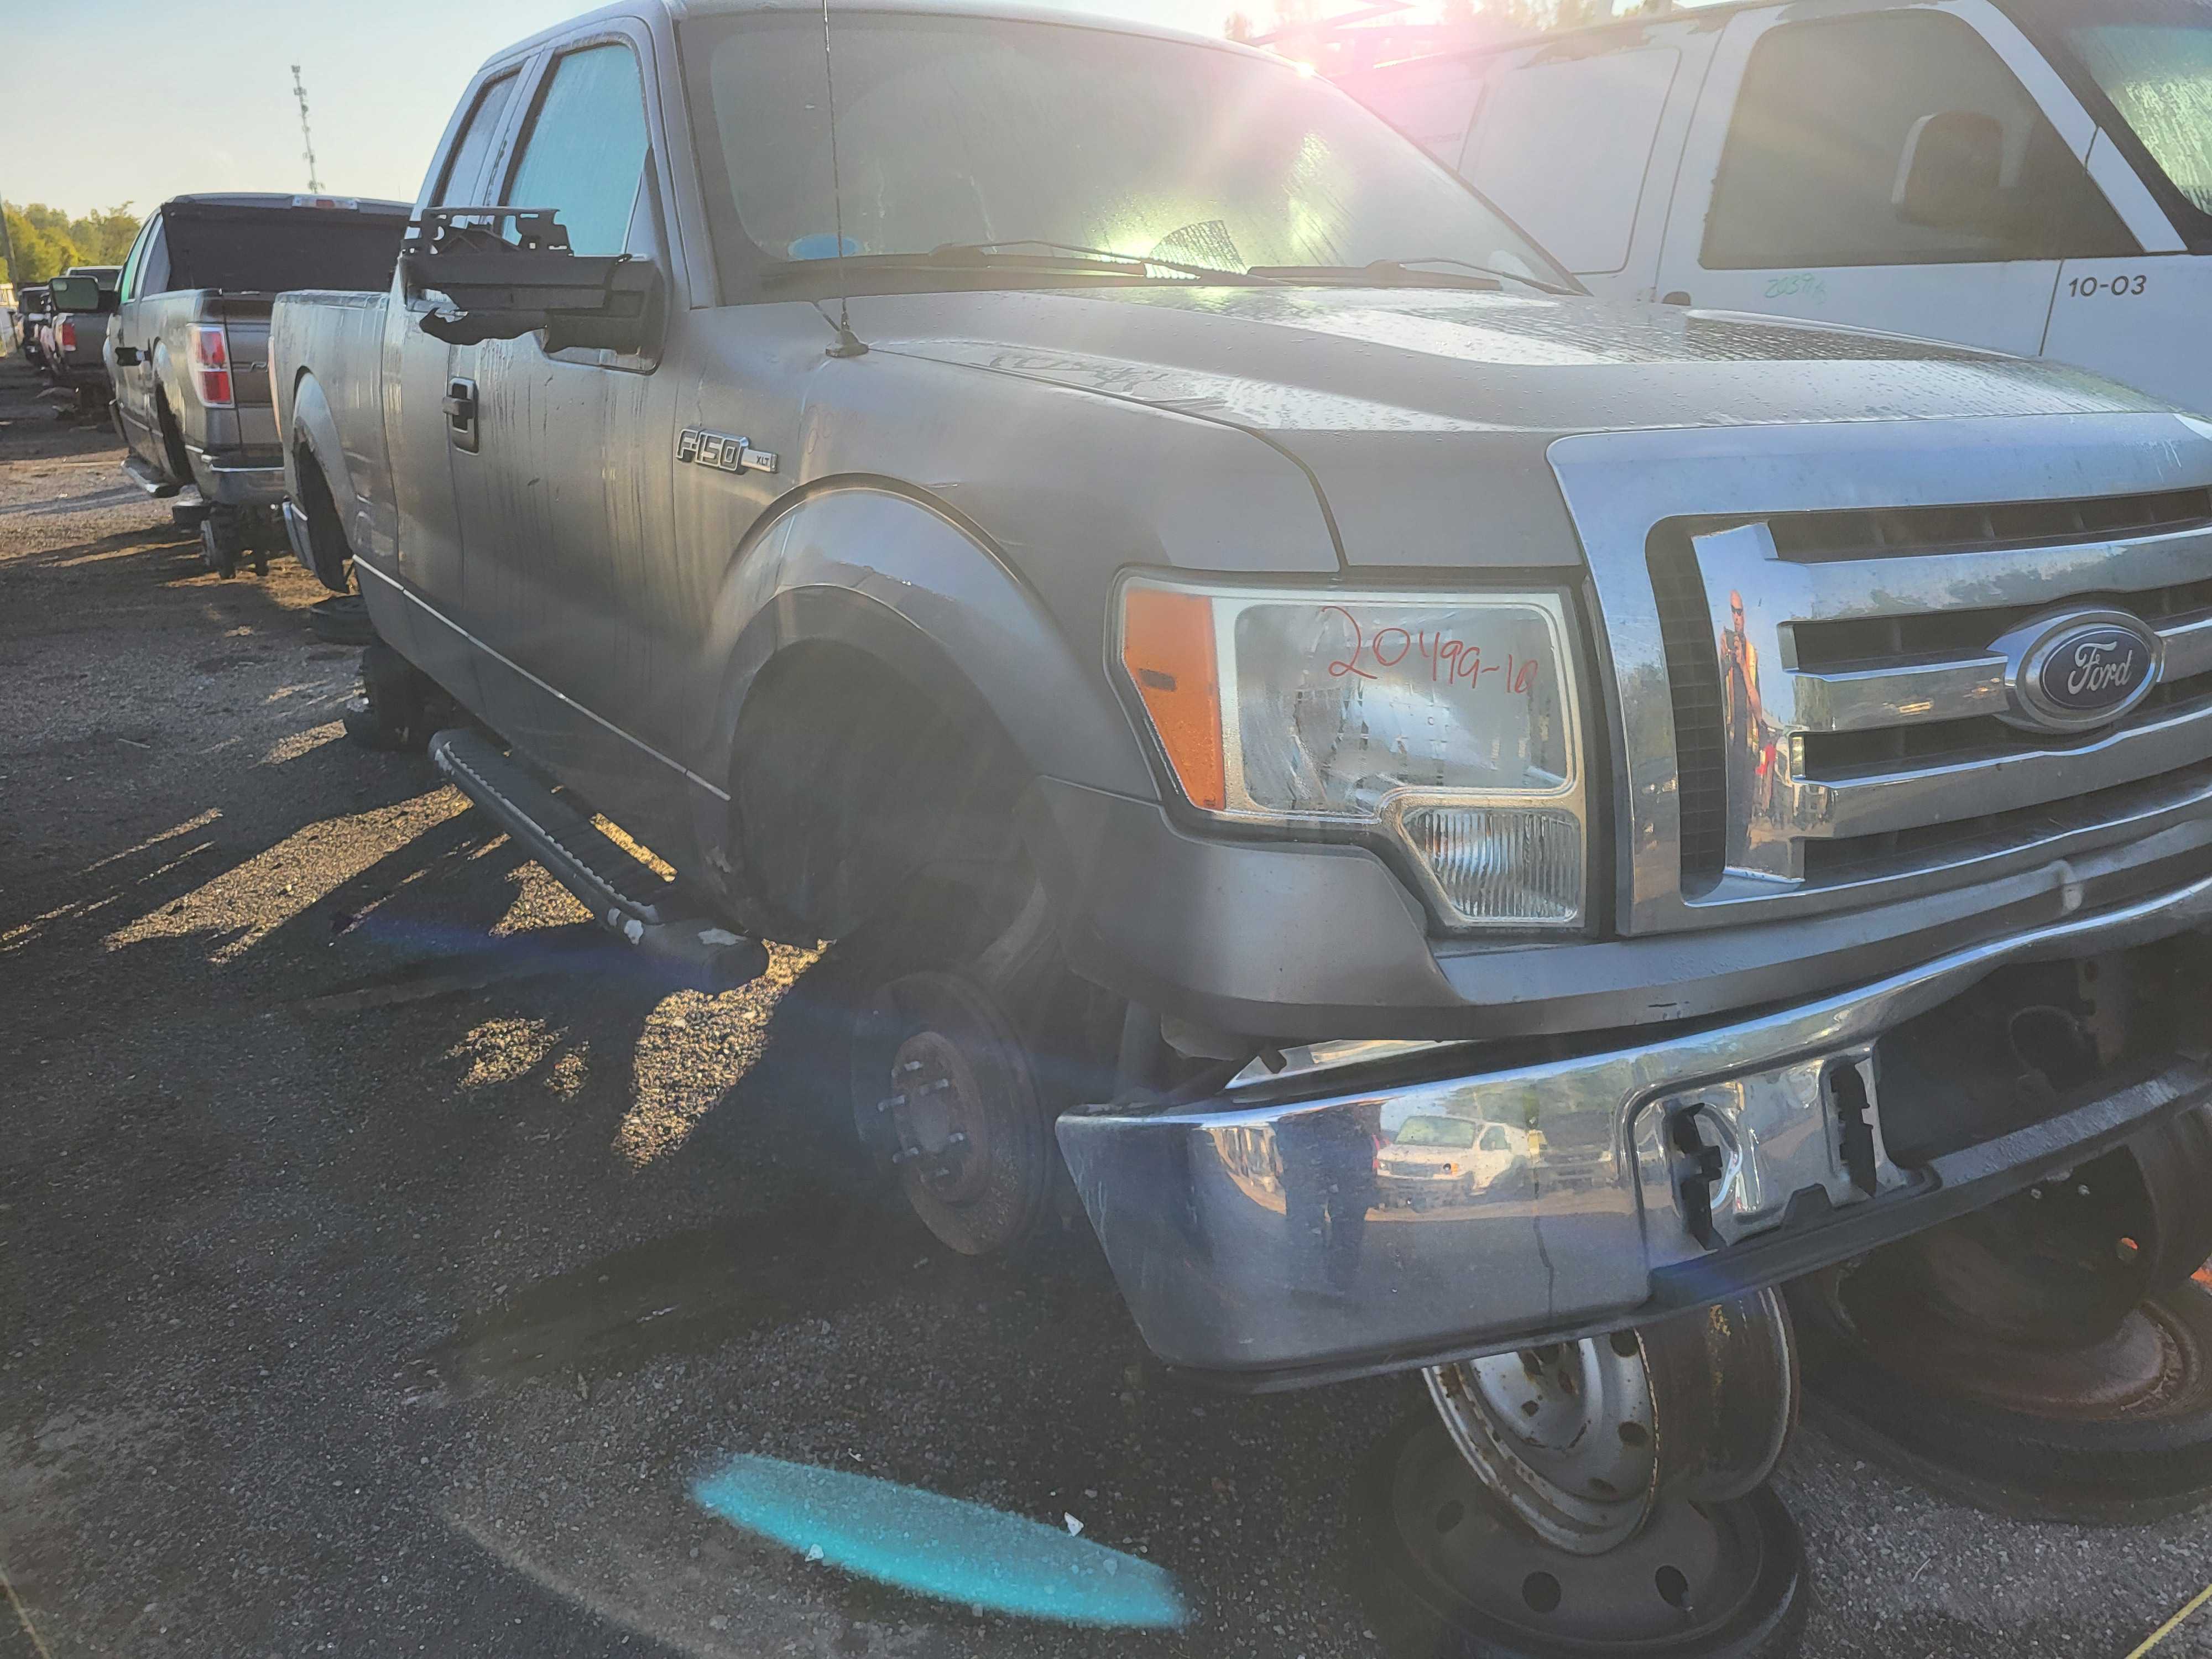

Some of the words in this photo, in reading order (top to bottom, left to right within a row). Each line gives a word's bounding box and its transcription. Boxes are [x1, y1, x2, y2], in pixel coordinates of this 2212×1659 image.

[2069, 275, 2147, 297] 10-03
[756, 455, 770, 466] XLT
[2067, 640, 2133, 695] Ford
